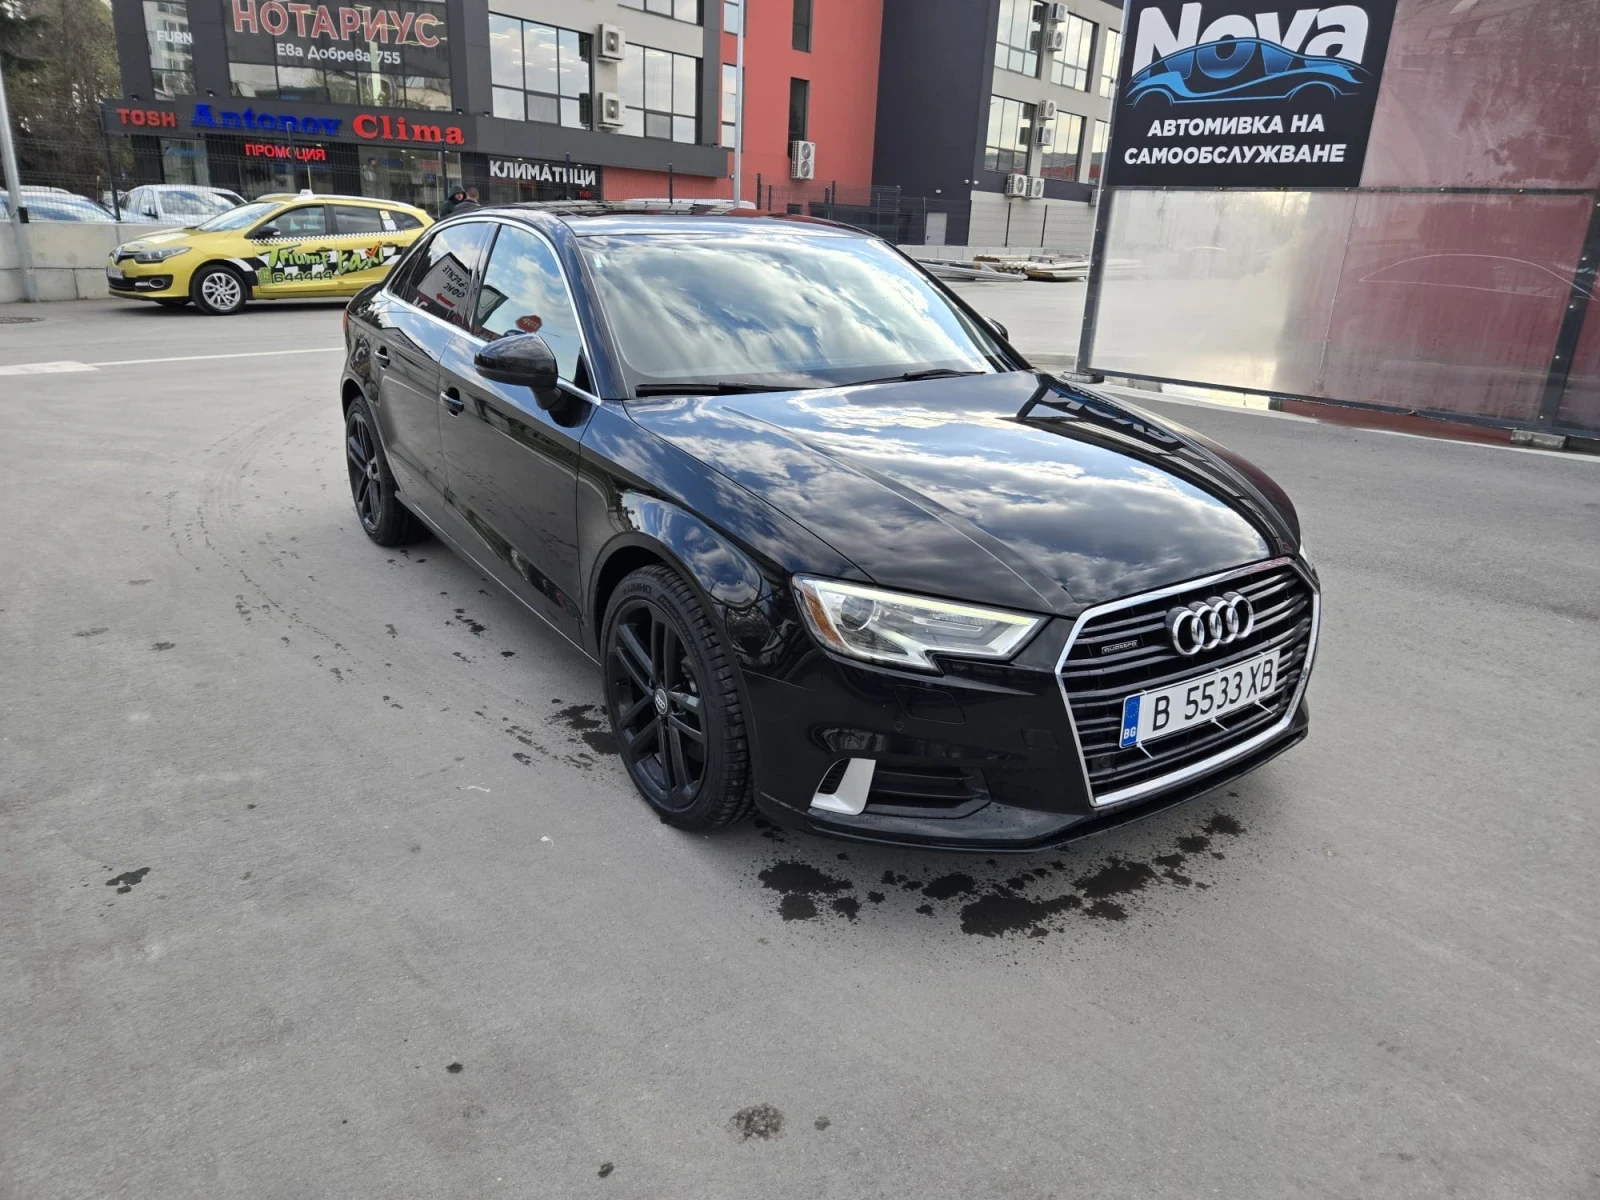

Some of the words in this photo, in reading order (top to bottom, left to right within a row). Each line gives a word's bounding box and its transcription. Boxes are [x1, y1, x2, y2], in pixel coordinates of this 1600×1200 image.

[231, 0, 440, 48] НОТАРИУС
[1131, 2, 1369, 79] Nova
[276, 43, 303, 57] Ева
[307, 45, 371, 63] Добрева
[376, 51, 401, 65] 755
[116, 107, 177, 128] TOSH
[191, 103, 343, 136] Antonov
[352, 113, 465, 145] Clima
[1147, 115, 1284, 138] АВТОМИВКА
[1290, 113, 1325, 133] НА
[1124, 144, 1348, 165] САМООБСЛУЖВАНЕ
[1152, 695, 1170, 732] B
[1184, 671, 1243, 721] 5533
[1246, 658, 1274, 699] XB
[1123, 725, 1137, 738] BG
